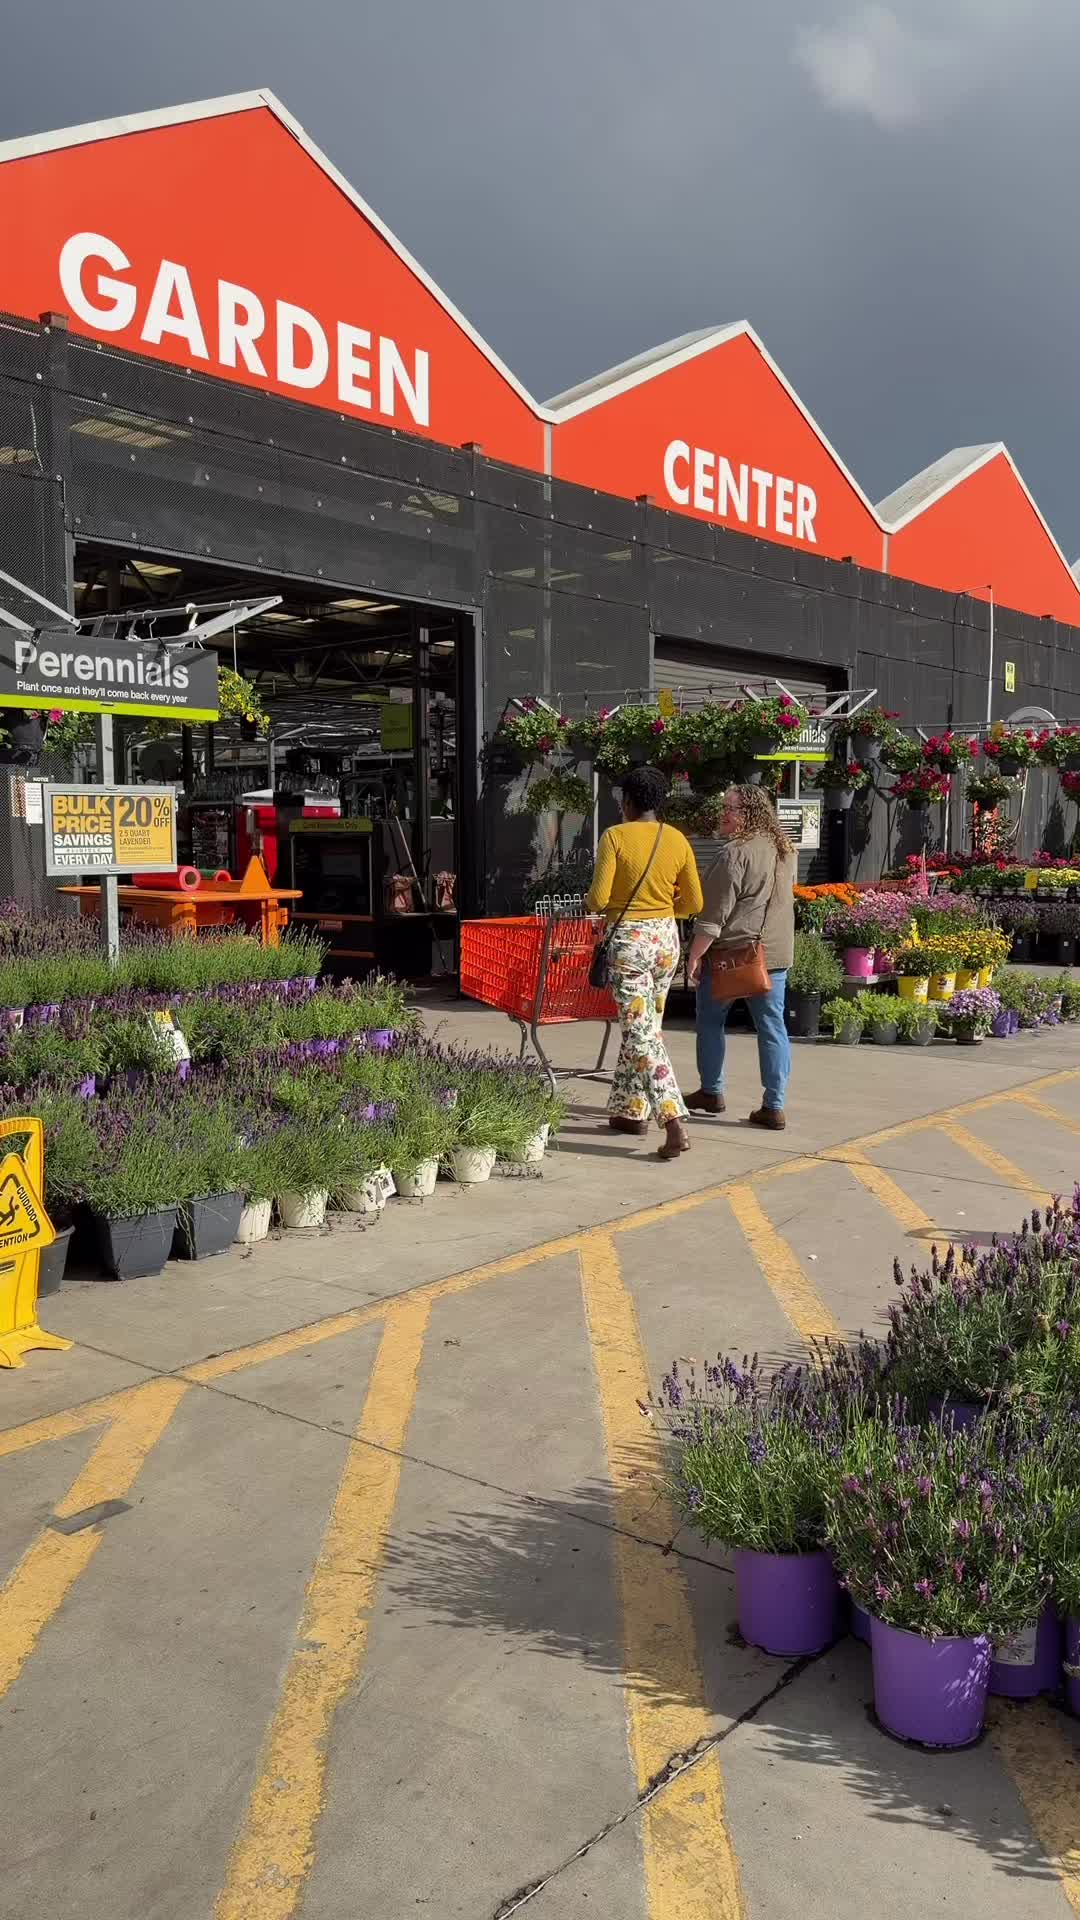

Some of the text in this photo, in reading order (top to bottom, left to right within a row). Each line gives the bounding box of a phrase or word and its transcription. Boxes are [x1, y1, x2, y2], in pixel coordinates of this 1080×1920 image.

[59, 232, 430, 427] GARDEN
[663, 440, 817, 543] CENTER
[14, 640, 189, 689] Perennials
[16, 680, 188, 704] Plant once and they'll come back every year
[53, 795, 112, 815] BULK
[119, 796, 152, 828] 20
[53, 815, 112, 833] PRICE
[130, 829, 150, 837] QUART
[154, 817, 170, 828] OFF
[54, 834, 113, 846] SAVINGS
[54, 854, 90, 865] EVERY
[93, 854, 113, 865] DAY
[17, 1186, 37, 1221] CUIDADO
